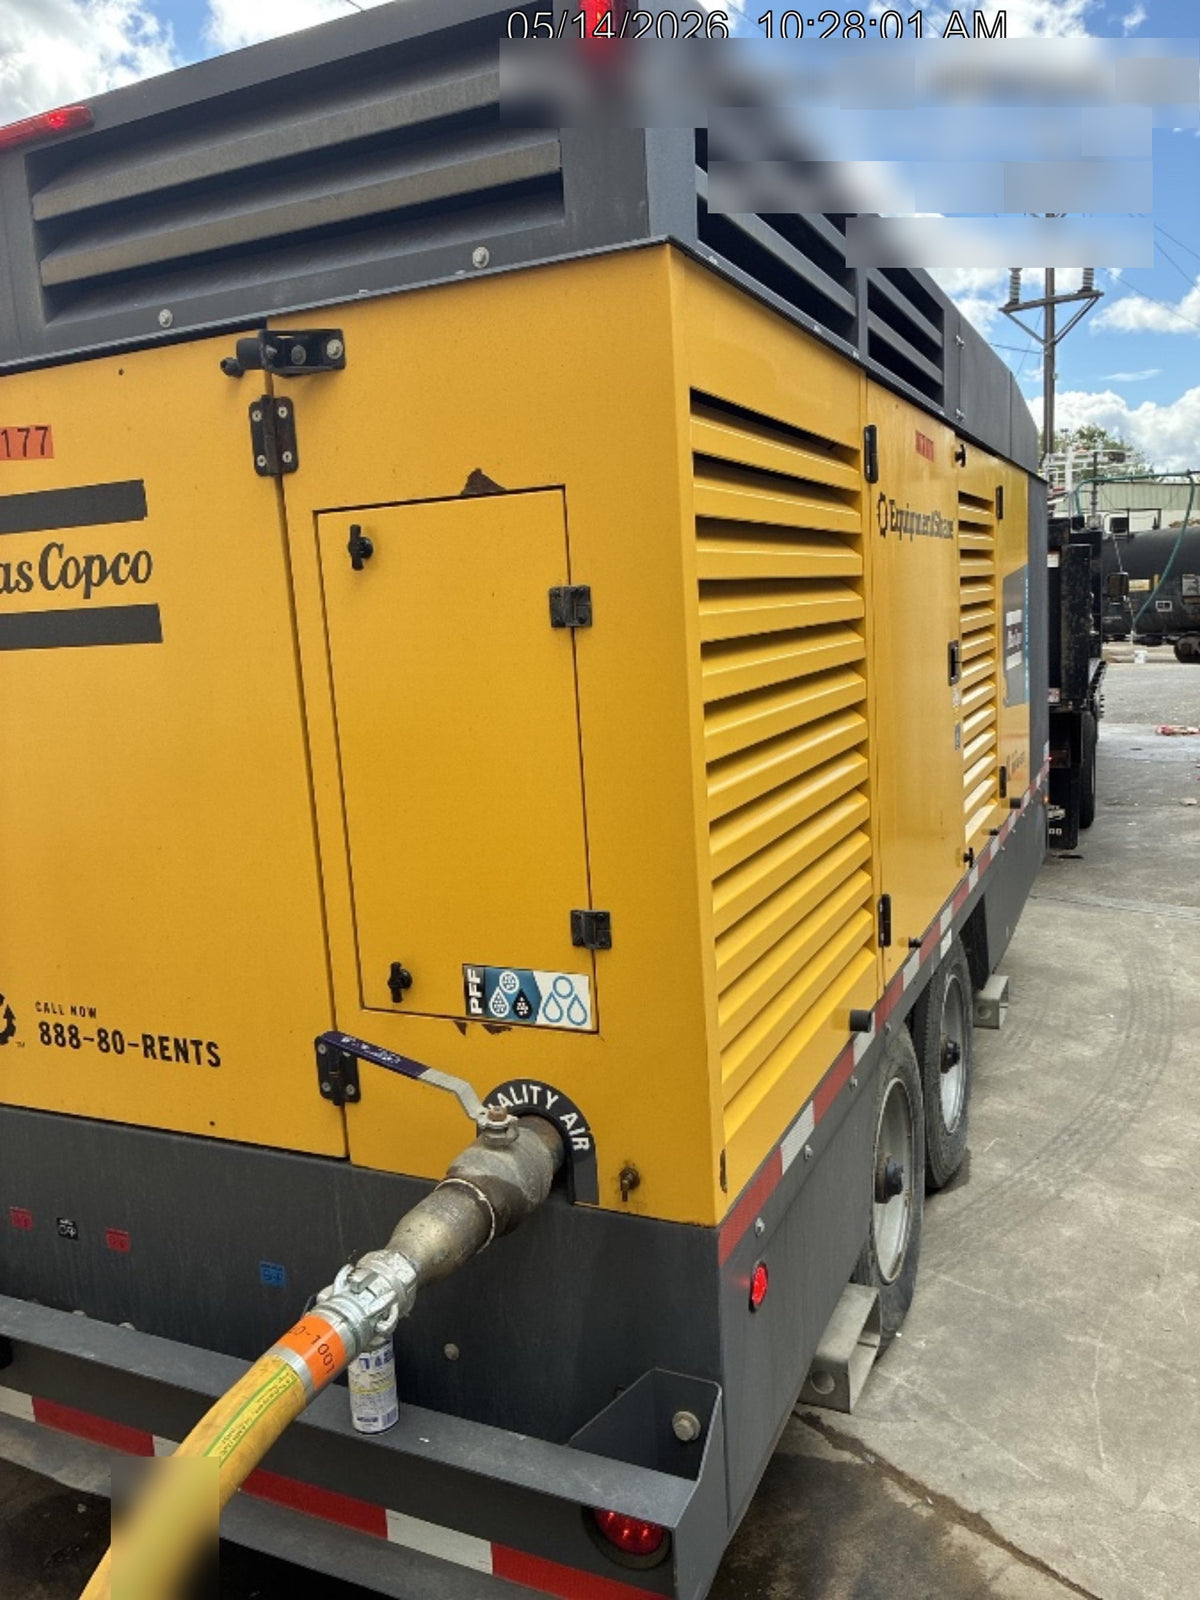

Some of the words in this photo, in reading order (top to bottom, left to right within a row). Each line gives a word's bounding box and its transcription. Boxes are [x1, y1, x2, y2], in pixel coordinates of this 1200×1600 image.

[38, 541, 153, 600] Copco
[35, 1001, 65, 1016] CALL
[70, 1004, 97, 1019] NOW
[467, 968, 483, 1015] PFF
[38, 1020, 221, 1068] 888-80-RENTS
[487, 1084, 559, 1110] ALITY
[559, 1111, 591, 1152] AIR
